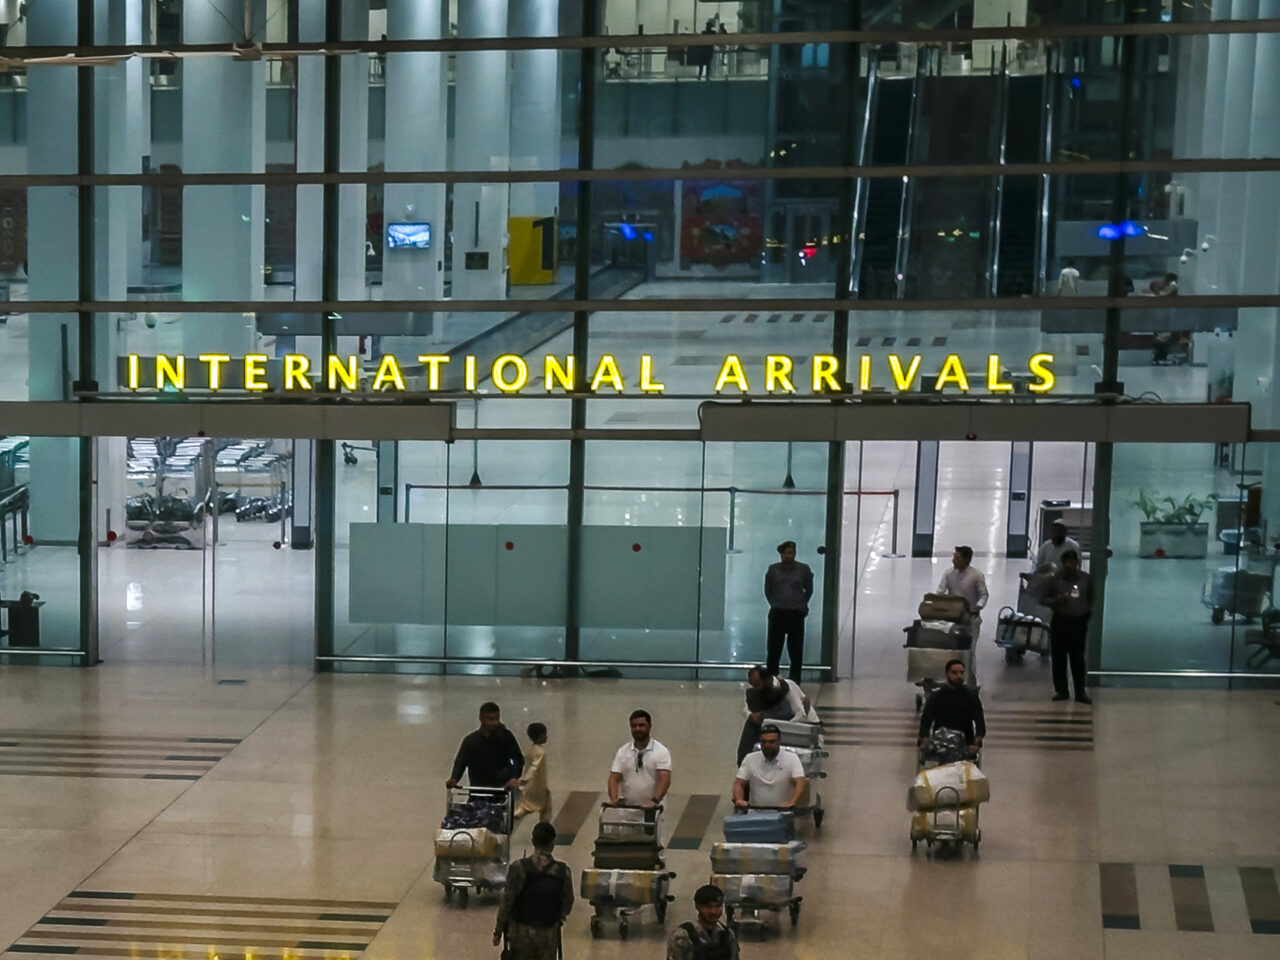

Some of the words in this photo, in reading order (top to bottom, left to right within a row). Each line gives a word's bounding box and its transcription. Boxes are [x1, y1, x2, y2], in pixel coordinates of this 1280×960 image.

[532, 217, 555, 270] 1
[127, 354, 665, 392] INTERNATIONAL
[714, 353, 1056, 392] ARRIVALS
